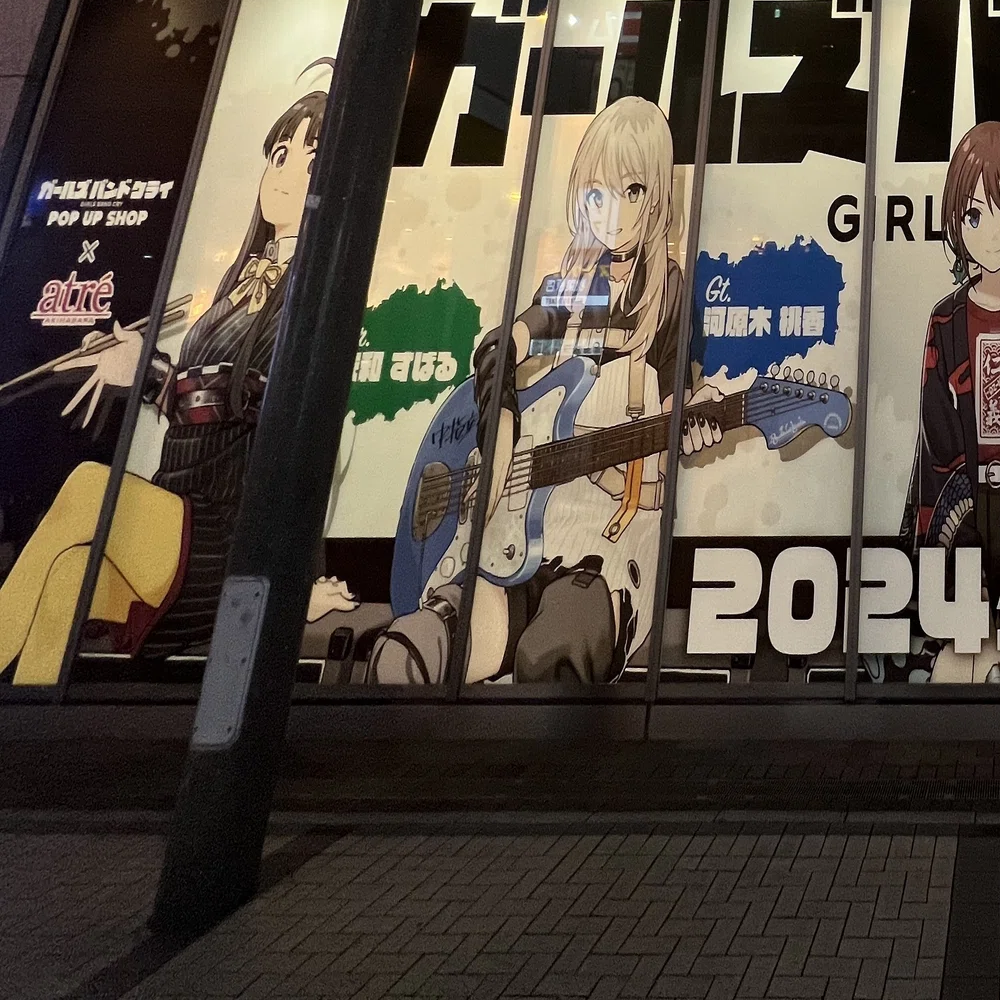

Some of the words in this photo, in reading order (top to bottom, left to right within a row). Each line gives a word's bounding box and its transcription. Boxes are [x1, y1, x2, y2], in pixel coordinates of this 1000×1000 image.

[37, 178, 175, 200] ガールズバンドクライ
[47, 210, 79, 227] POP
[82, 210, 103, 226] UP
[105, 210, 149, 227] SHOP
[38, 270, 115, 314] atré
[705, 275, 732, 302] Gt.
[704, 305, 772, 337] 河原木
[779, 305, 825, 337] 桃香
[390, 351, 458, 382] すばる
